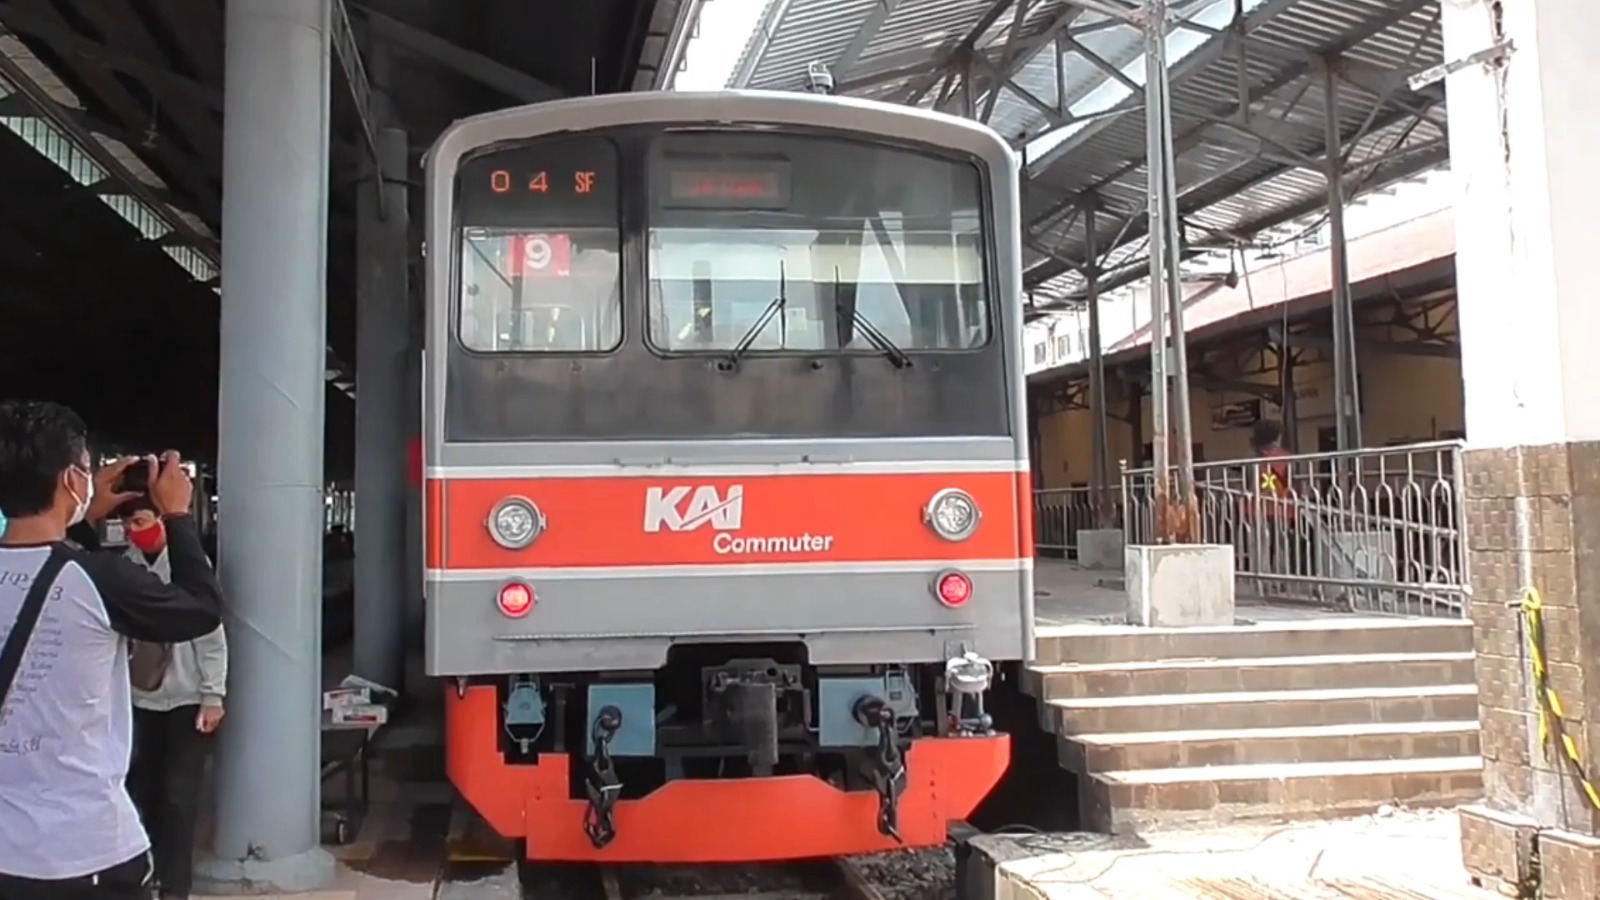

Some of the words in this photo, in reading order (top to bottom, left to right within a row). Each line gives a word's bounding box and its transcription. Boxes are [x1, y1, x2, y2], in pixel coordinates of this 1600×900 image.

[575, 171, 595, 192] SF
[525, 237, 552, 270] 9
[644, 485, 743, 532] KAI
[713, 532, 833, 554] Commuter
